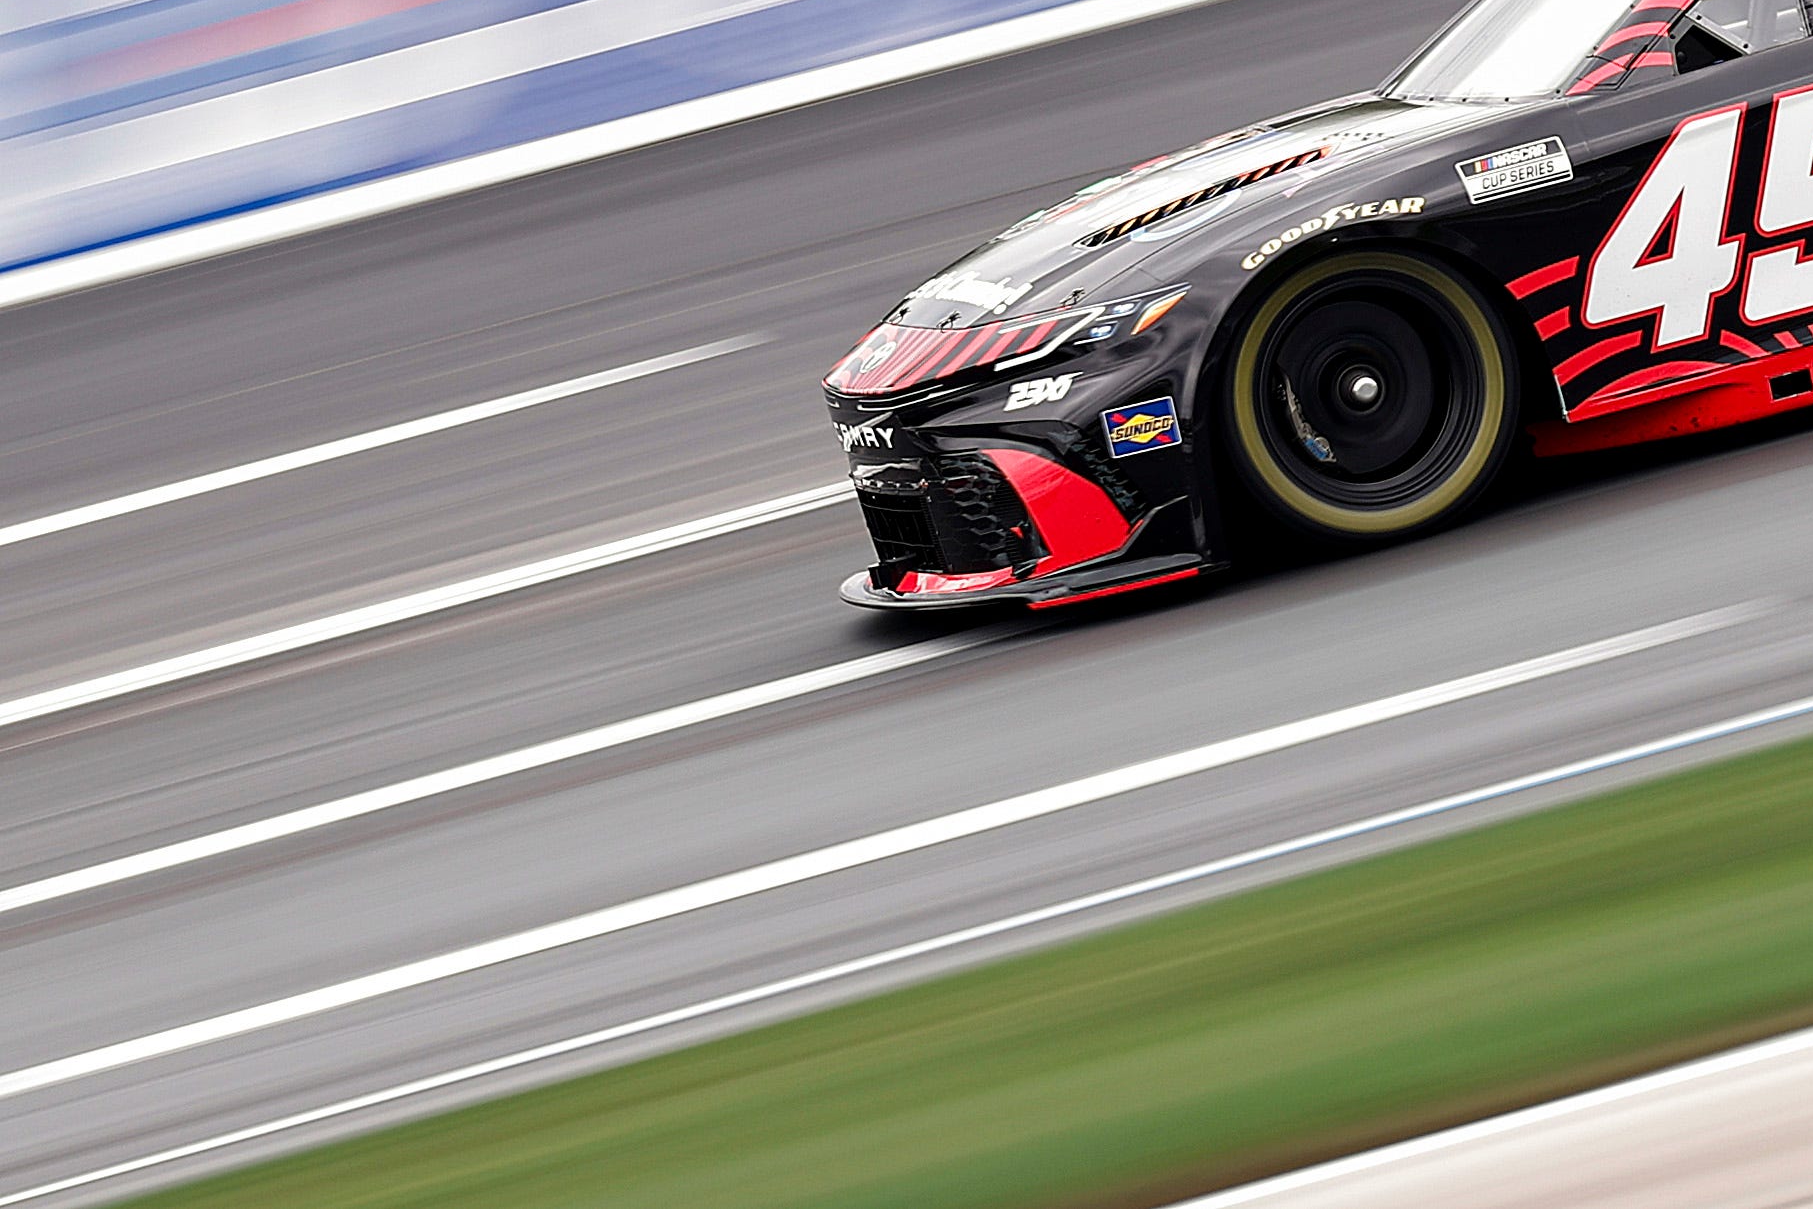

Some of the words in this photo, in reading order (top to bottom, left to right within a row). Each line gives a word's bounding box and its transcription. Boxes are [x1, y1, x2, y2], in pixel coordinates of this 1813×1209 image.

[1491, 143, 1547, 168] NASCAR
[1482, 173, 1507, 190] CUP
[1510, 160, 1555, 183] SERIES
[1241, 196, 1425, 270] GOODYEAR
[1113, 415, 1173, 442] SUNOCO
